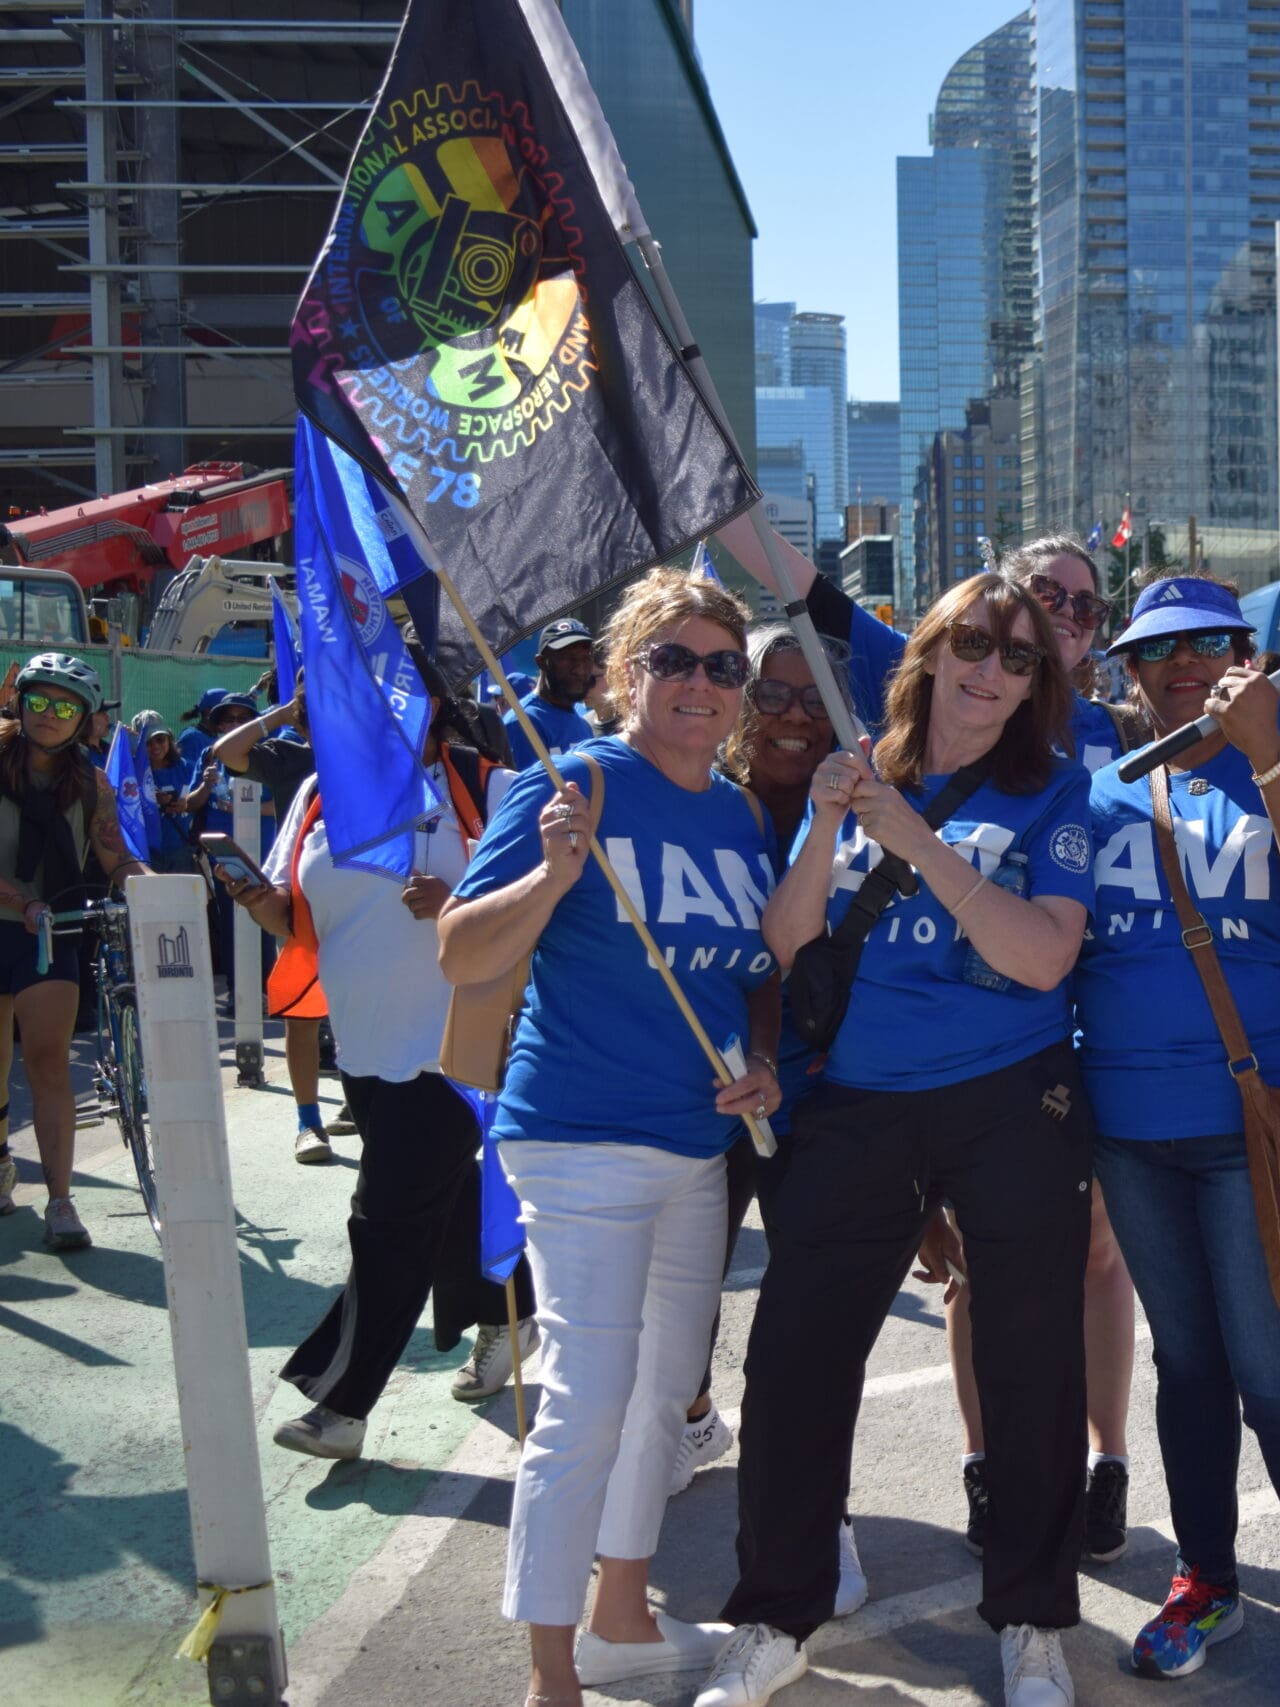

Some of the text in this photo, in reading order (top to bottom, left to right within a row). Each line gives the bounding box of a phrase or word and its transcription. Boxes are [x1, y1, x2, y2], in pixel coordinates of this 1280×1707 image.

[351, 312, 591, 437] AND AEROSPACE WORKERS
[426, 465, 482, 509] 78
[300, 557, 338, 644] IAMAW
[1095, 814, 1272, 901] AM
[1083, 909, 1250, 941] NIN
[157, 964, 195, 979] TORONTO
[647, 946, 777, 977] UNIO
